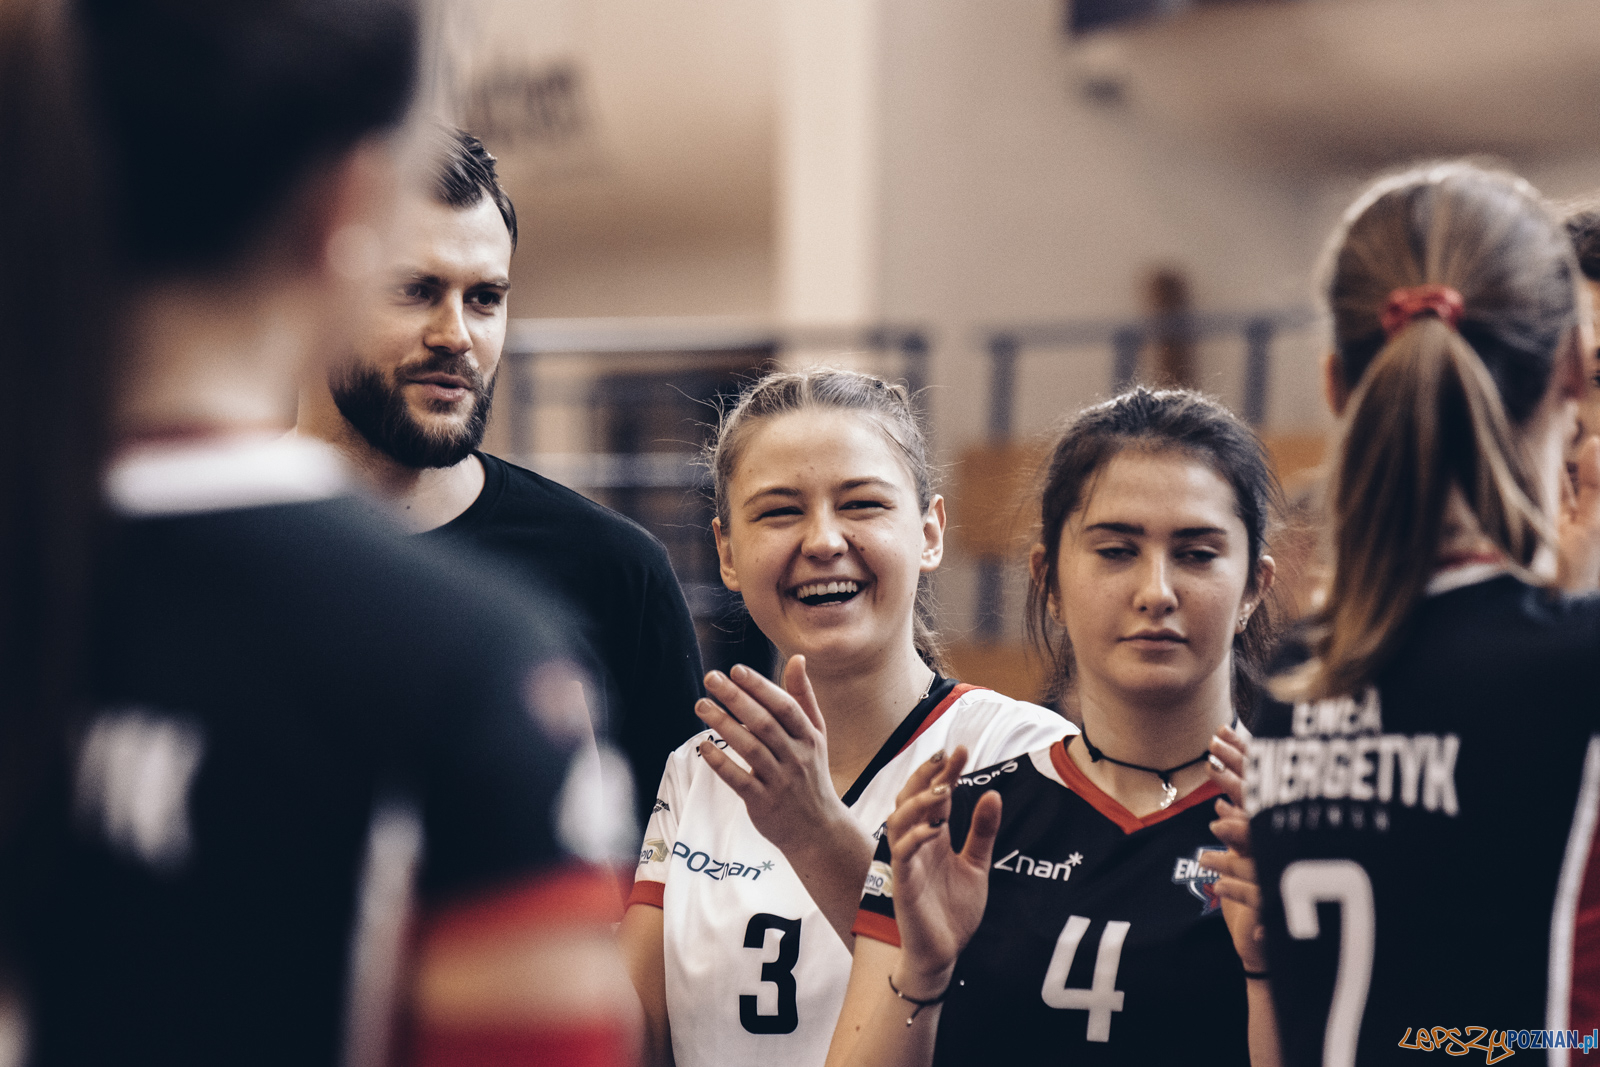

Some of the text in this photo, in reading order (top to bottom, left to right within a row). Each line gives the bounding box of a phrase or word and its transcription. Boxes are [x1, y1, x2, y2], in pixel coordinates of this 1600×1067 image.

[739, 912, 802, 1035] 3
[1041, 915, 1131, 1043] 4
[1280, 859, 1376, 1067] 7
